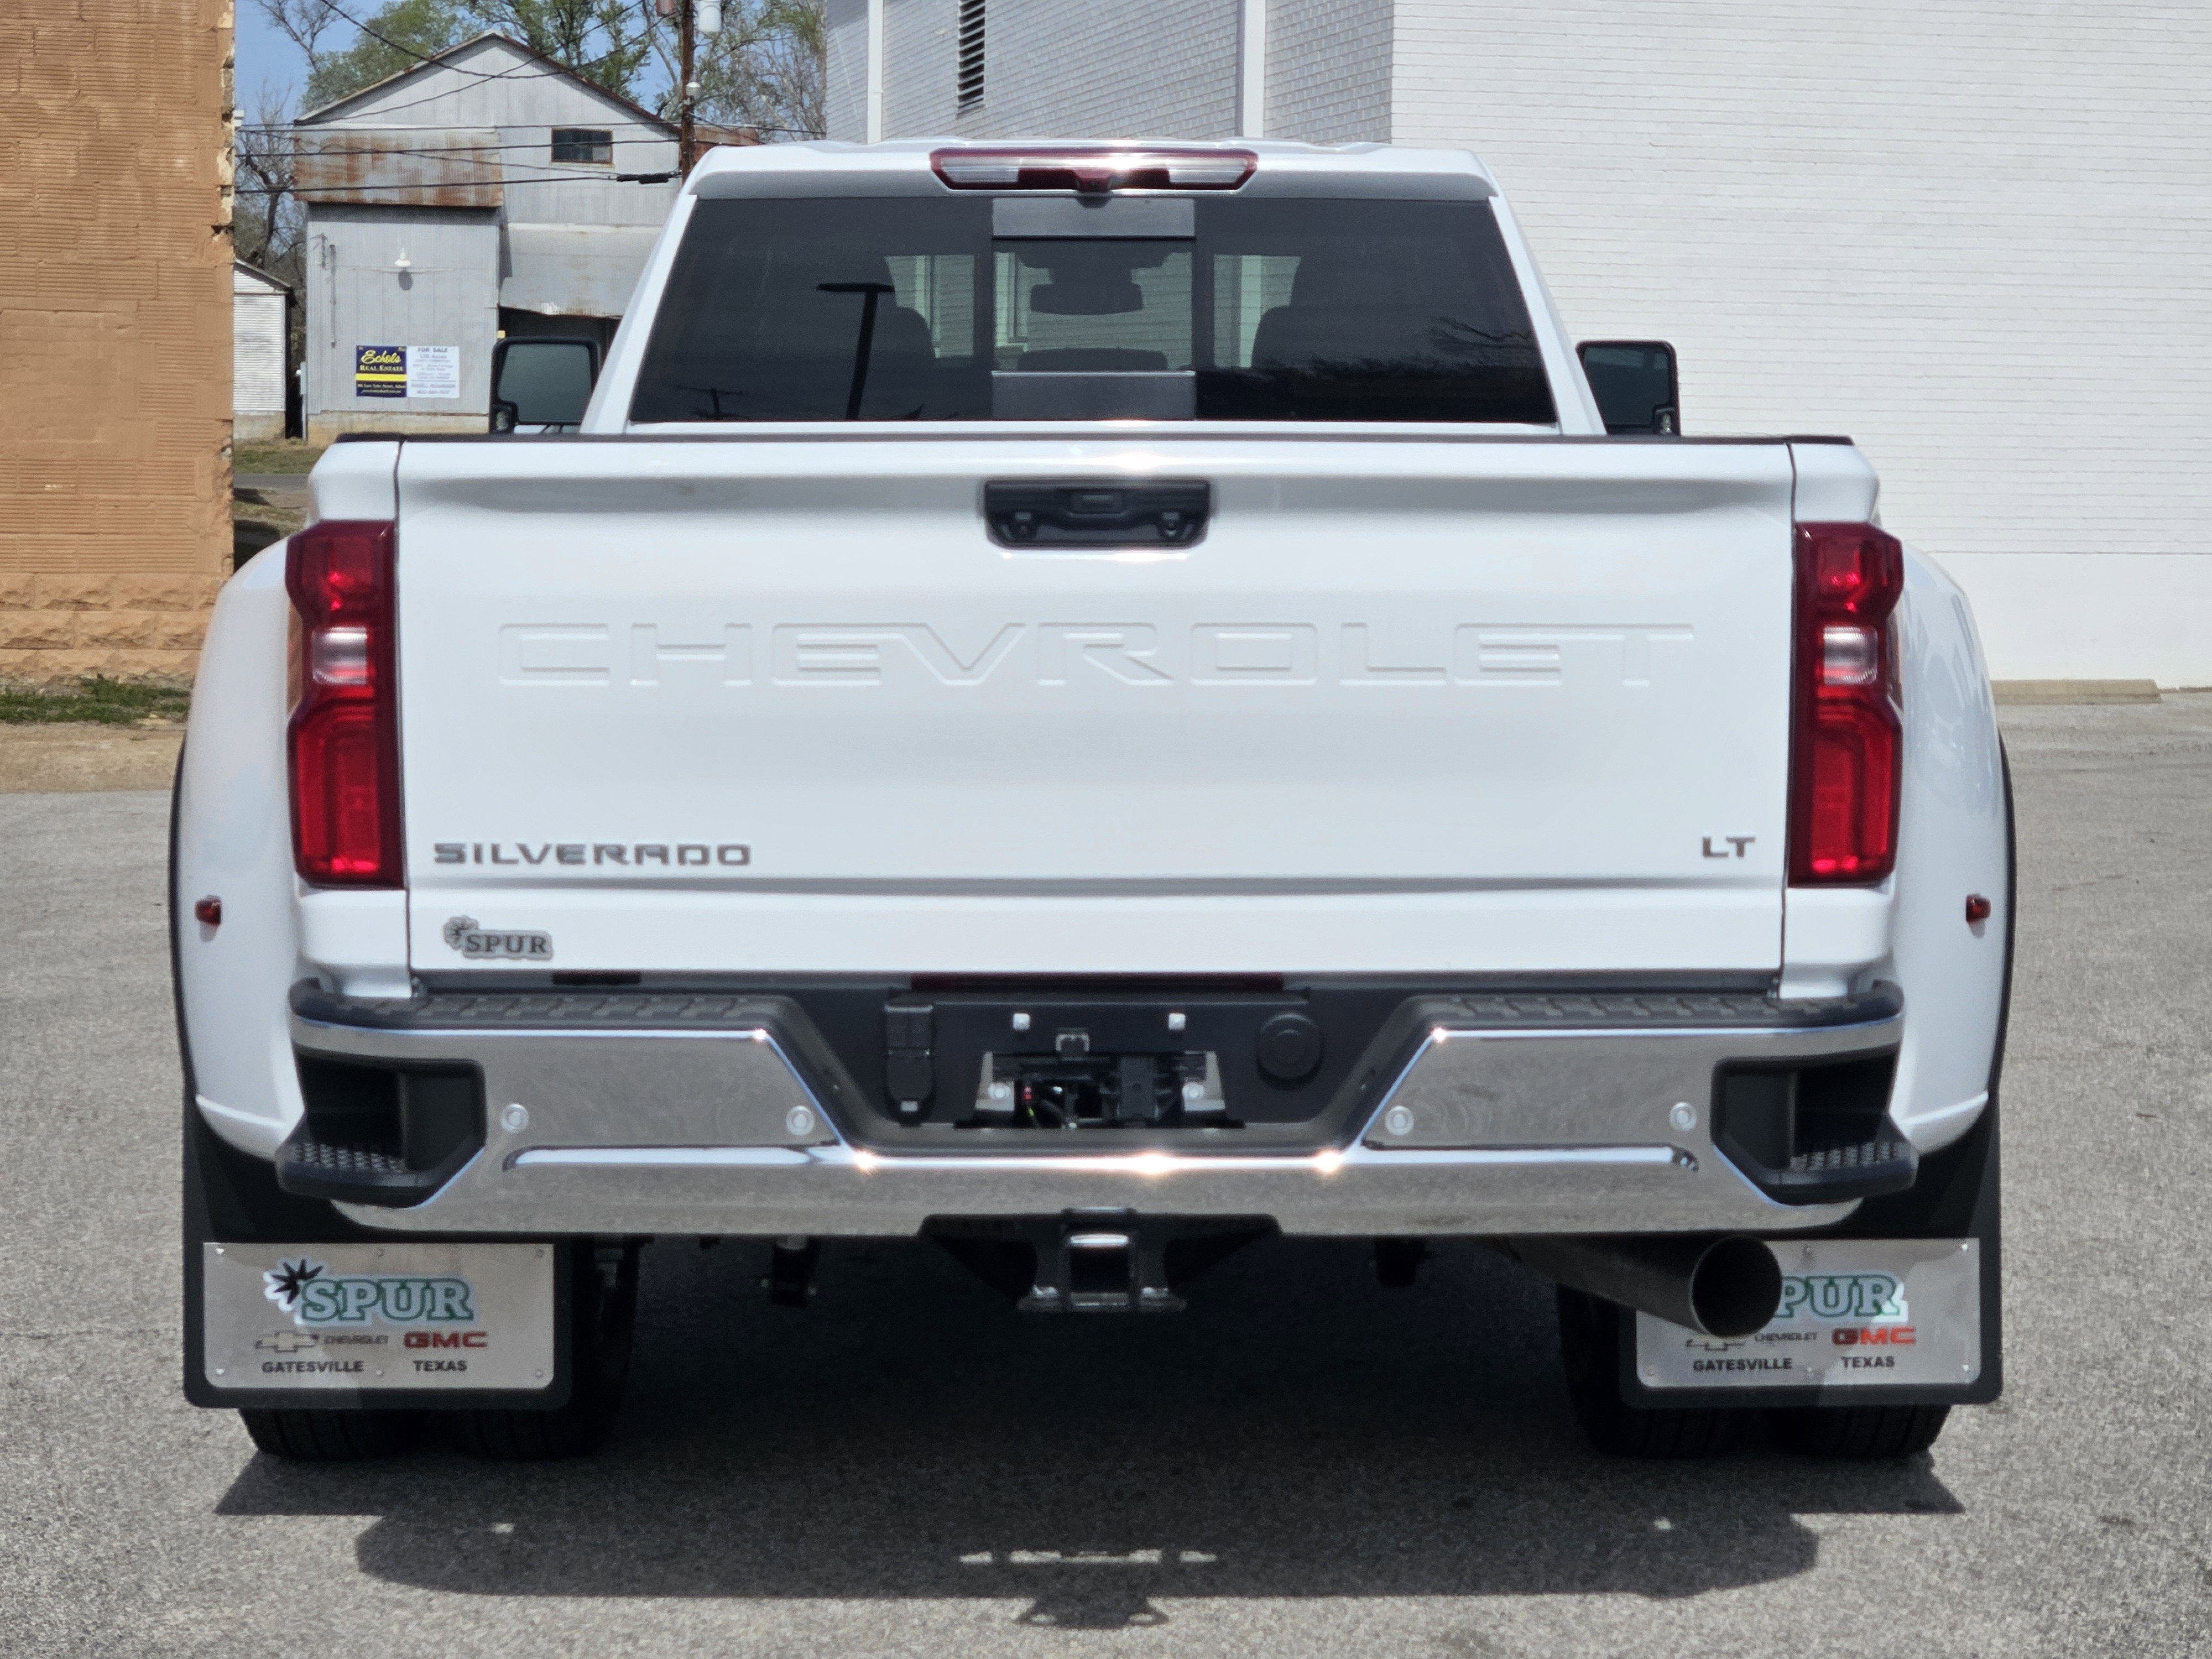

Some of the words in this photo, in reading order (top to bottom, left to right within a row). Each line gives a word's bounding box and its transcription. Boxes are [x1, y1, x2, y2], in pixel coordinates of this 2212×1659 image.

[361, 350, 401, 364] Echols
[499, 622, 1694, 686] CHEVROLET
[434, 842, 751, 866] SILVERADO
[1702, 836, 1756, 858] LT
[465, 933, 550, 954] SPUR
[301, 1278, 474, 1321] SPUR
[1773, 1274, 1901, 1318] PUR
[403, 1331, 488, 1349] GMC
[1832, 1327, 1916, 1345] GMC
[262, 1360, 364, 1373] GATESVILLE
[413, 1359, 467, 1372] TEXAS
[1693, 1357, 1793, 1372] GATESVILLE
[1841, 1355, 1895, 1368] TEXAS
